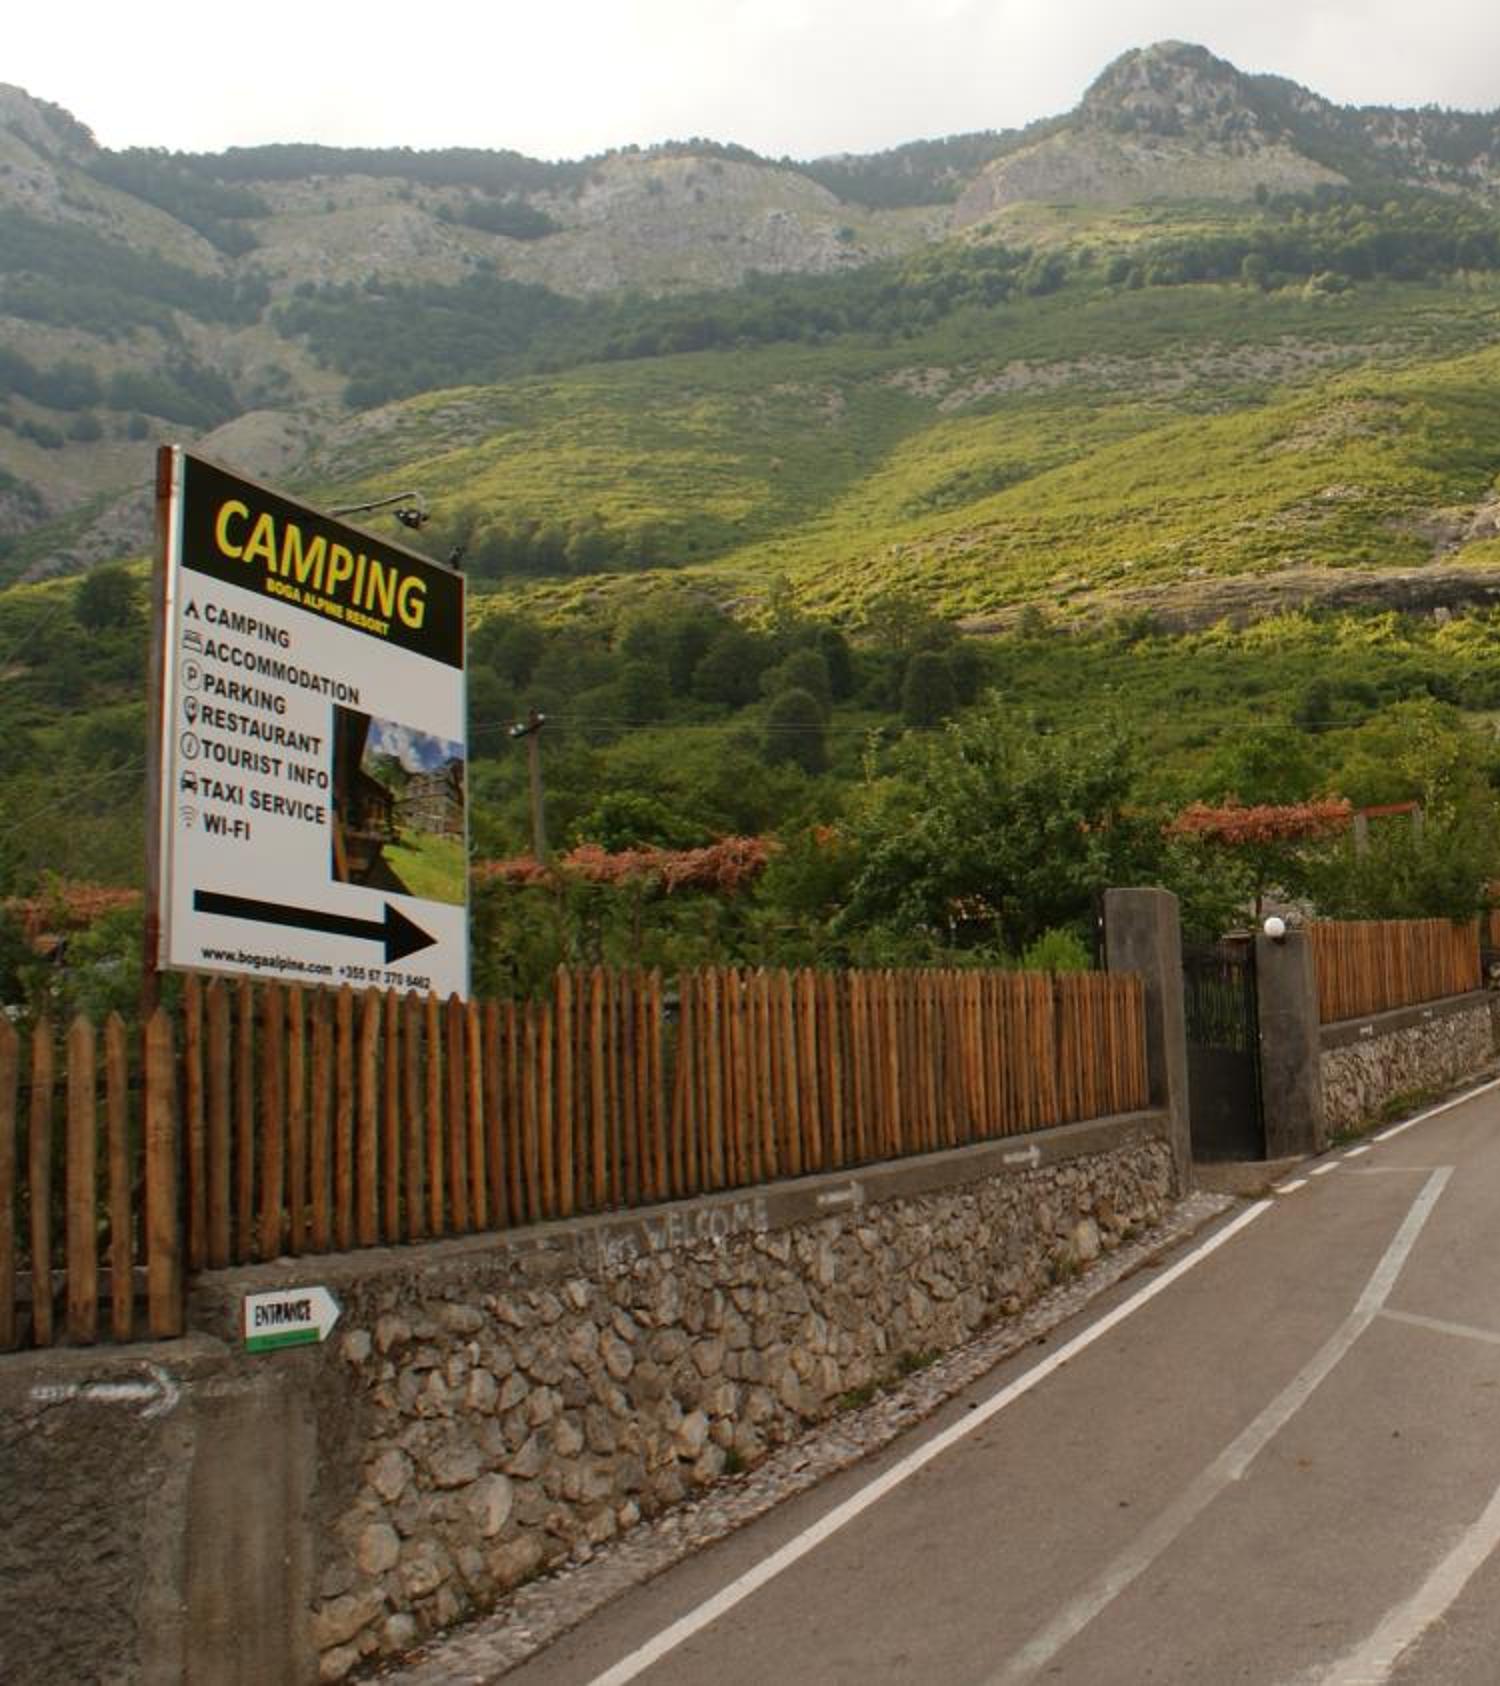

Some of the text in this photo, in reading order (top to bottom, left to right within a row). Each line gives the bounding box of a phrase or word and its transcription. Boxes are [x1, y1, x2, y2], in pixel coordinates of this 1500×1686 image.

[214, 499, 427, 629] CAMPING
[204, 603, 290, 648] CAMPING
[266, 577, 390, 636] BOGA ALPINE RESORT
[203, 639, 359, 704] ACCOMMODATION
[204, 673, 286, 714] PARKING
[201, 705, 322, 755] RESTAURANT
[201, 739, 329, 790] TOURIST INFO
[200, 778, 326, 825] TAXI SERVICE
[203, 813, 250, 840] WI-FI
[201, 947, 333, 976] www.bogaalpine.com
[255, 1299, 312, 1327] ENTRANCE
